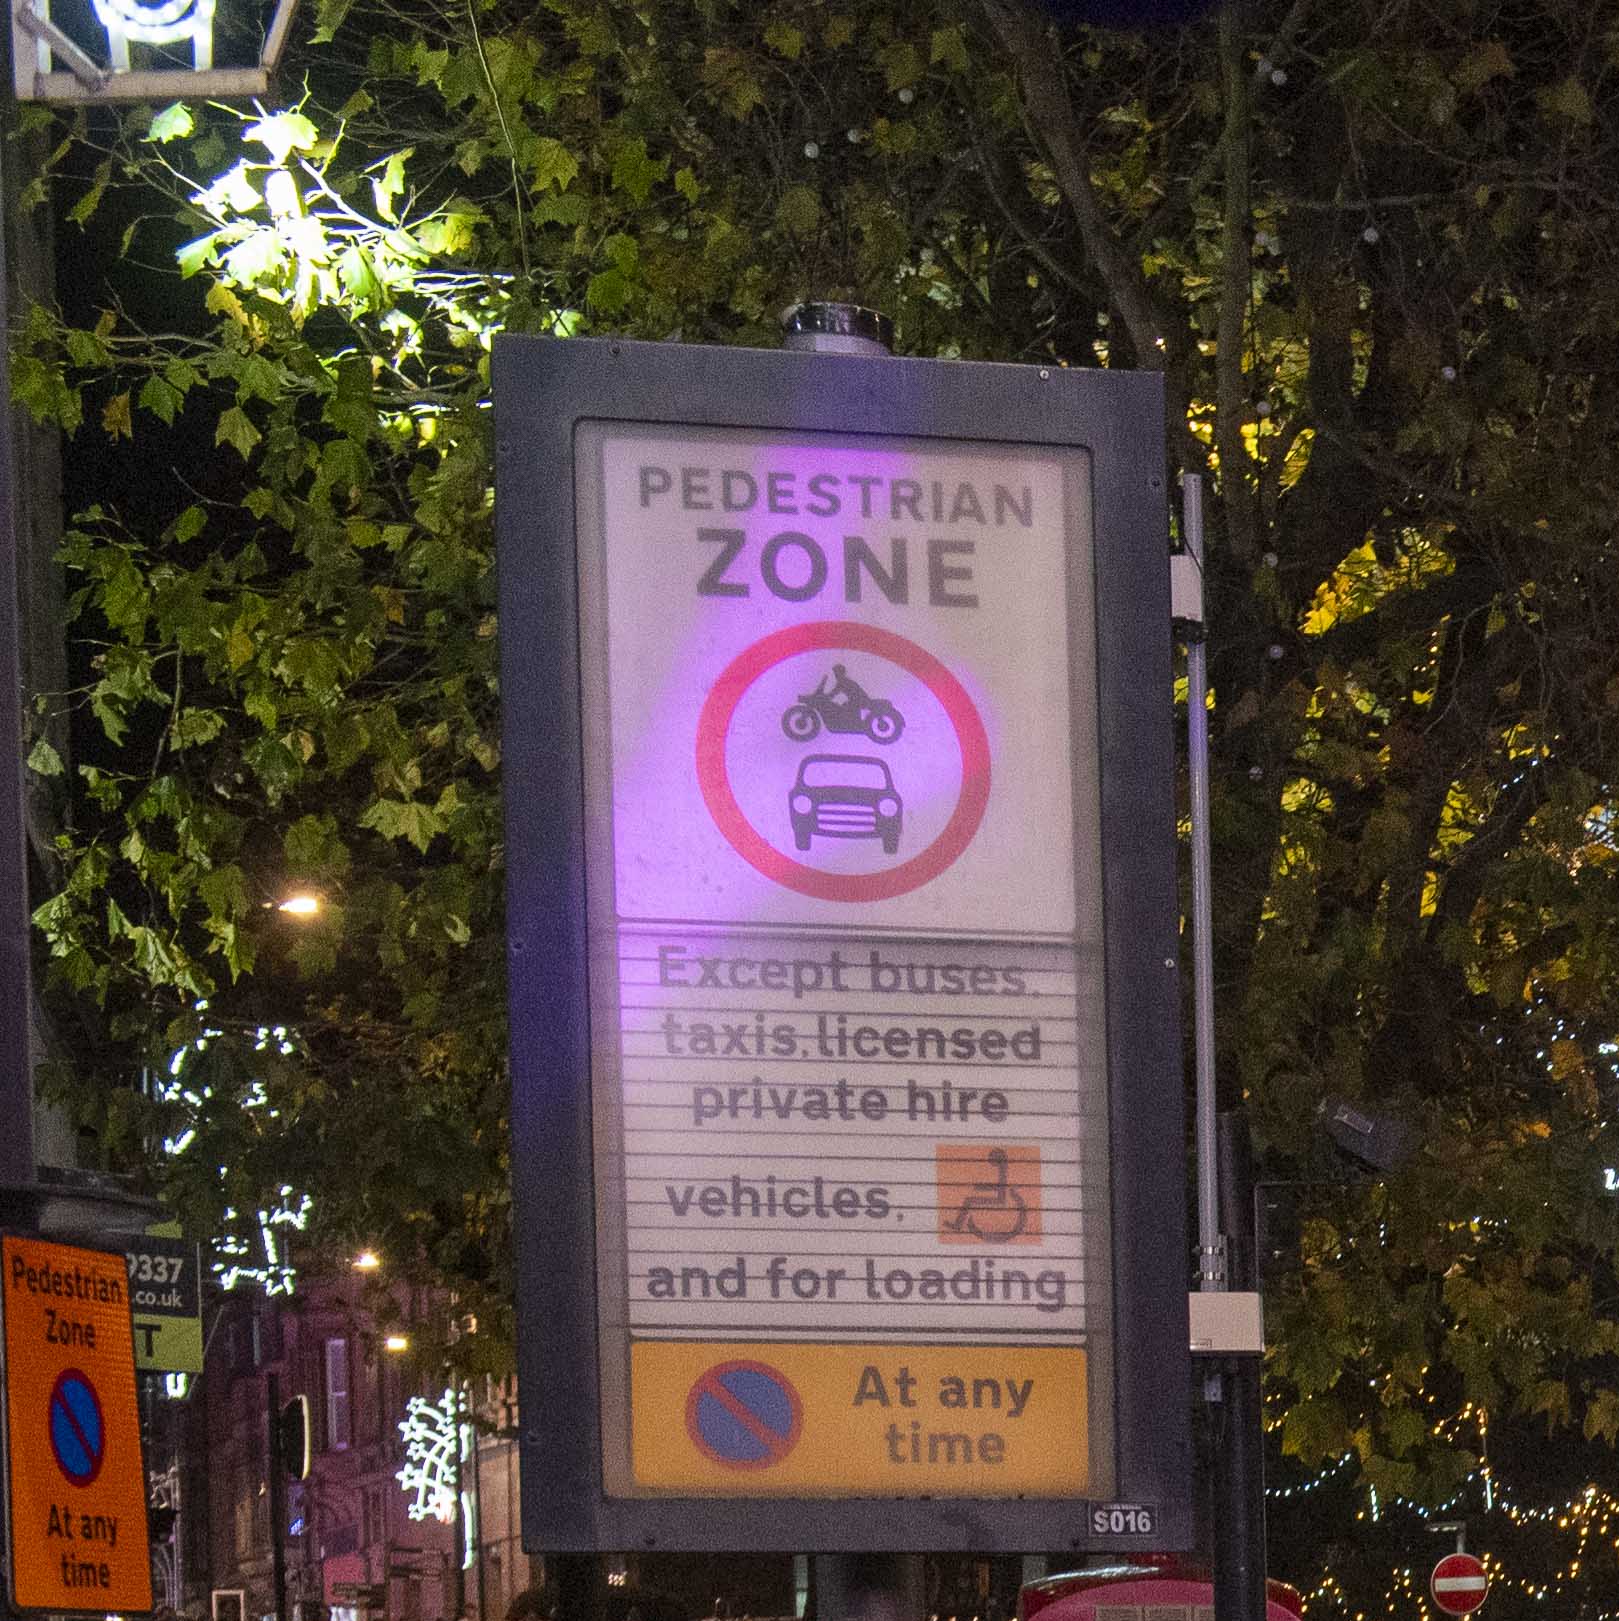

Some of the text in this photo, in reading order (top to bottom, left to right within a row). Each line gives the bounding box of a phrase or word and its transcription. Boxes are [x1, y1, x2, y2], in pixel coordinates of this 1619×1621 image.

[638, 466, 1034, 527] PEDESTRIAN
[696, 528, 979, 608] ZONE
[657, 945, 850, 998] Except
[692, 1076, 1009, 1126] private hire
[11, 1255, 122, 1305] Pedestrian
[647, 1257, 1067, 1312] and for loading
[45, 1308, 96, 1348] Zone
[853, 1366, 1034, 1417] At any
[885, 1423, 1006, 1465] time
[47, 1503, 118, 1547] At any
[1094, 1511, 1152, 1533] S016
[61, 1553, 110, 1588] time
